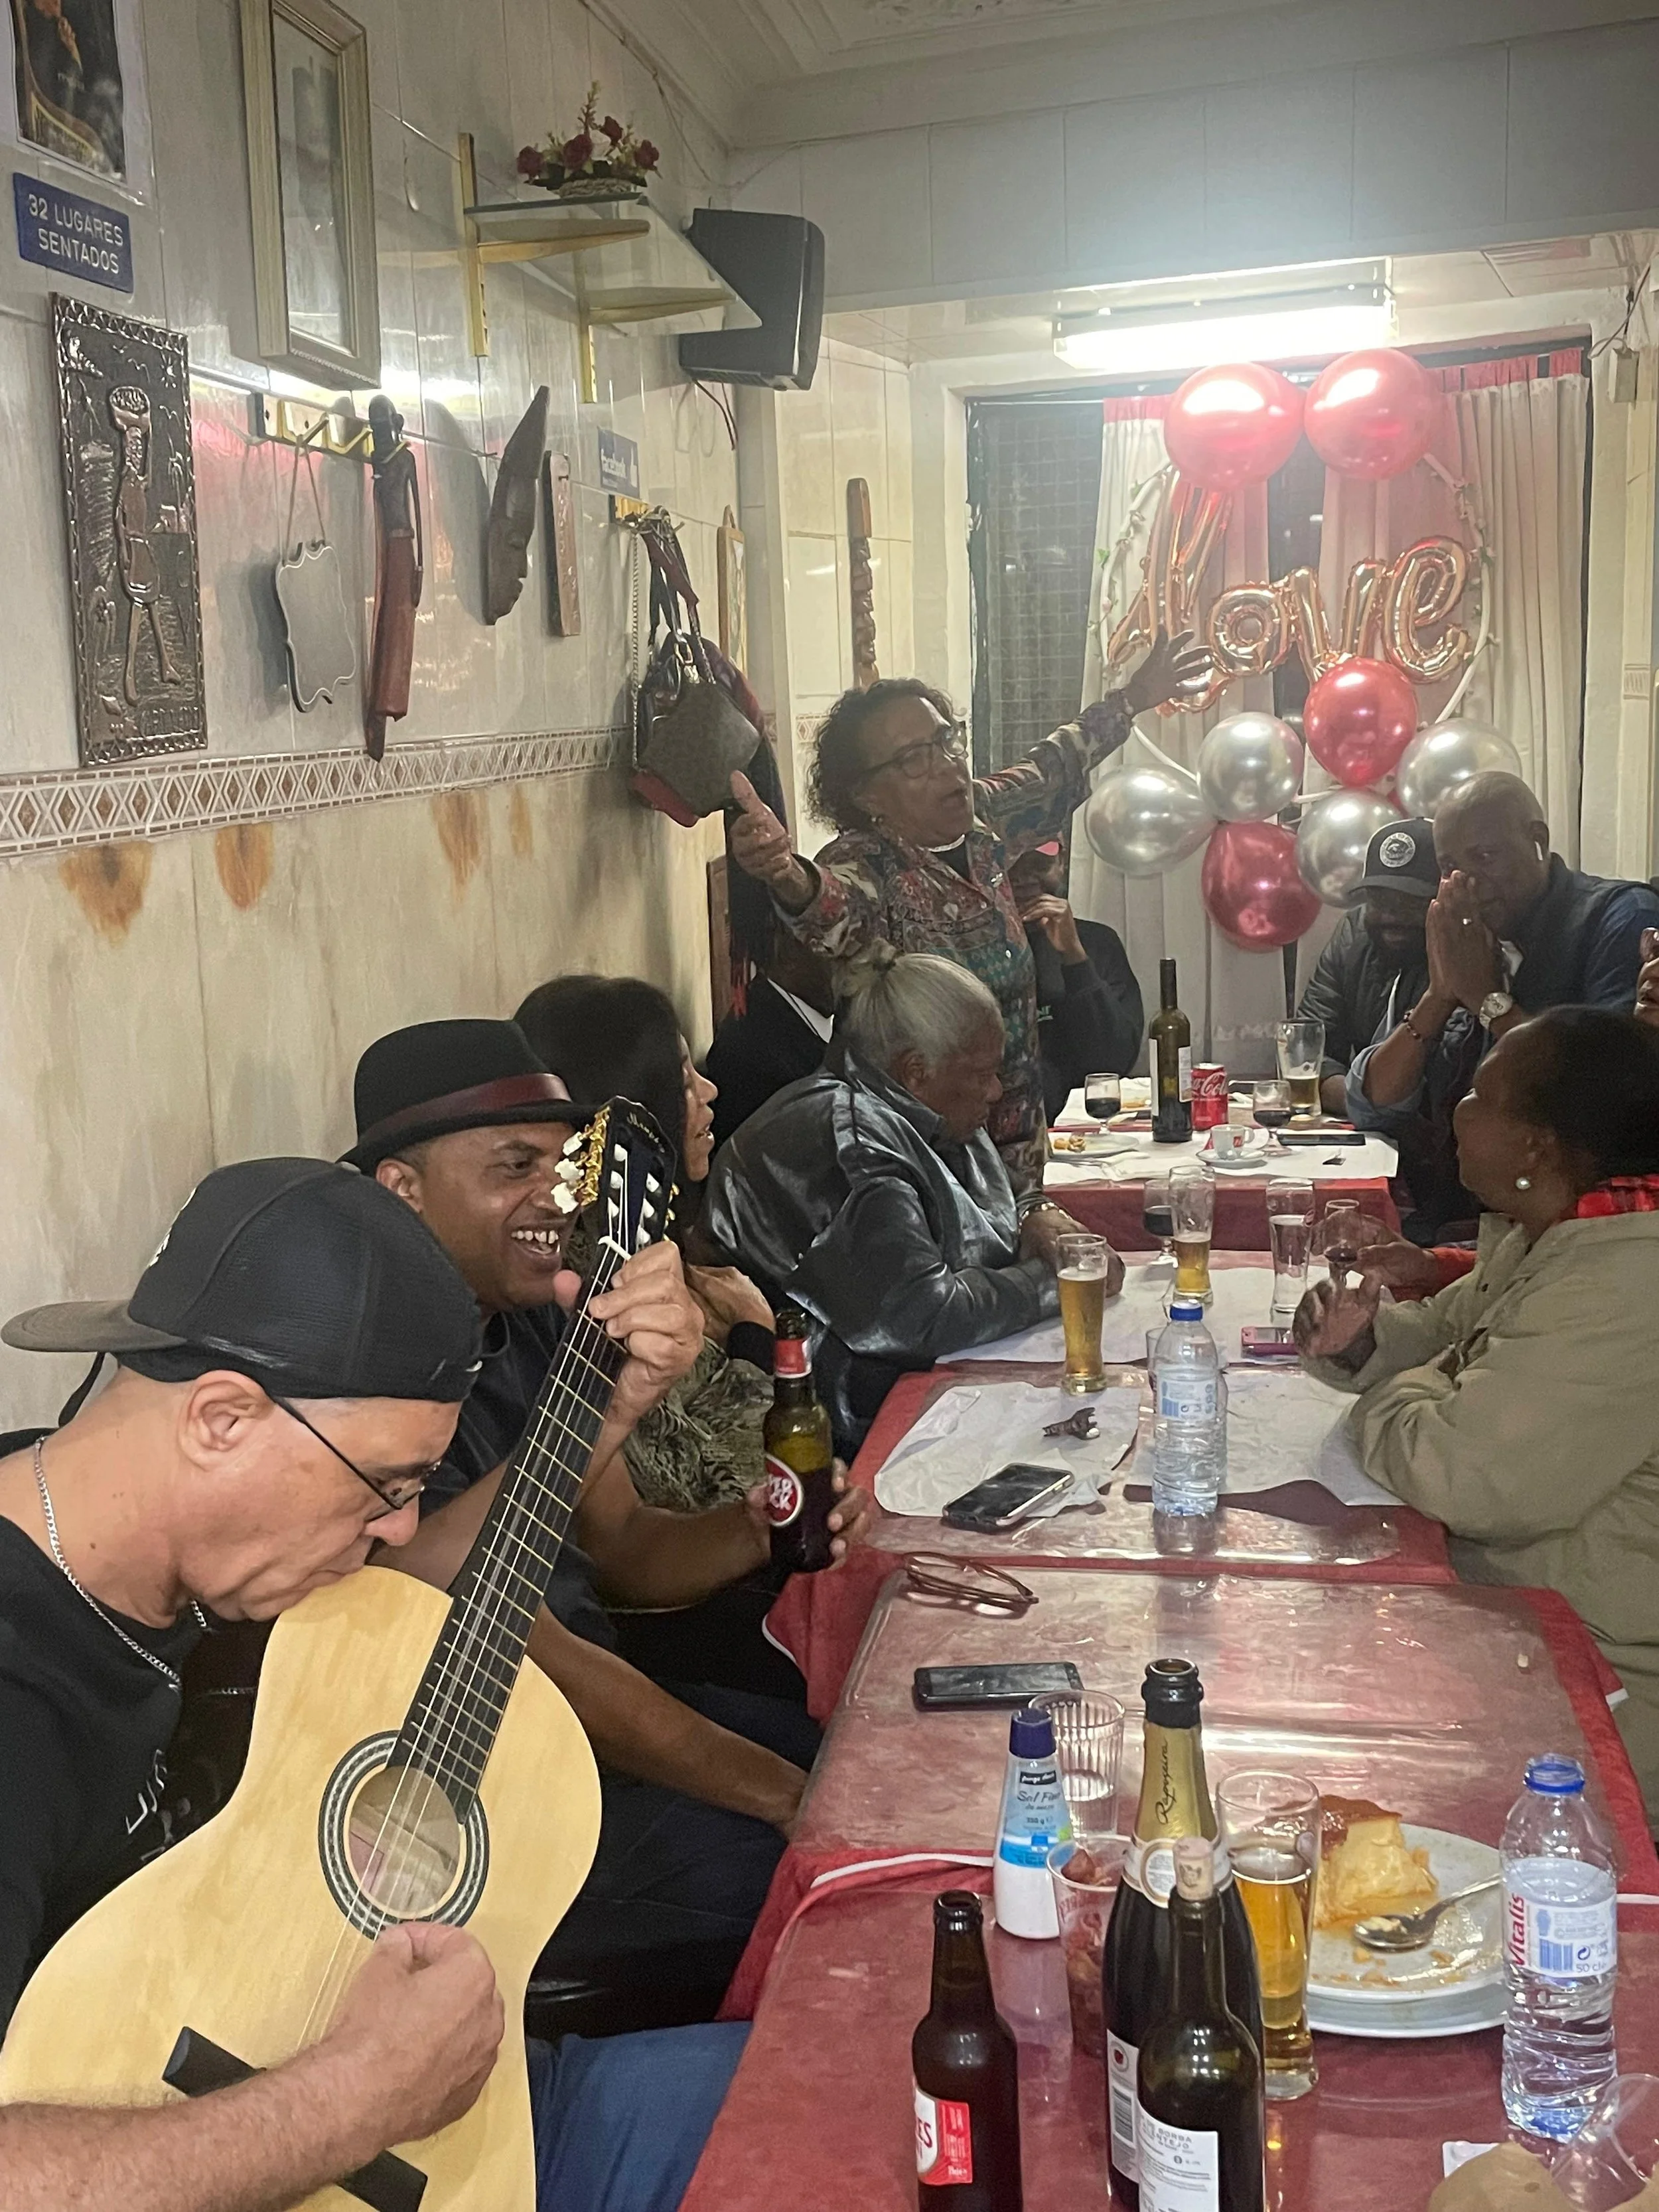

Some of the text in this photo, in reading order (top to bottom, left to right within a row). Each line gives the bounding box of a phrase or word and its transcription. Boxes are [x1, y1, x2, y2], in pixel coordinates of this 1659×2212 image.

[29, 194, 123, 246] 32 LUGARES
[38, 228, 119, 274] SENTADOS
[1508, 1893, 1524, 1966] Vitalis
[1576, 1963, 1590, 1972] 50
